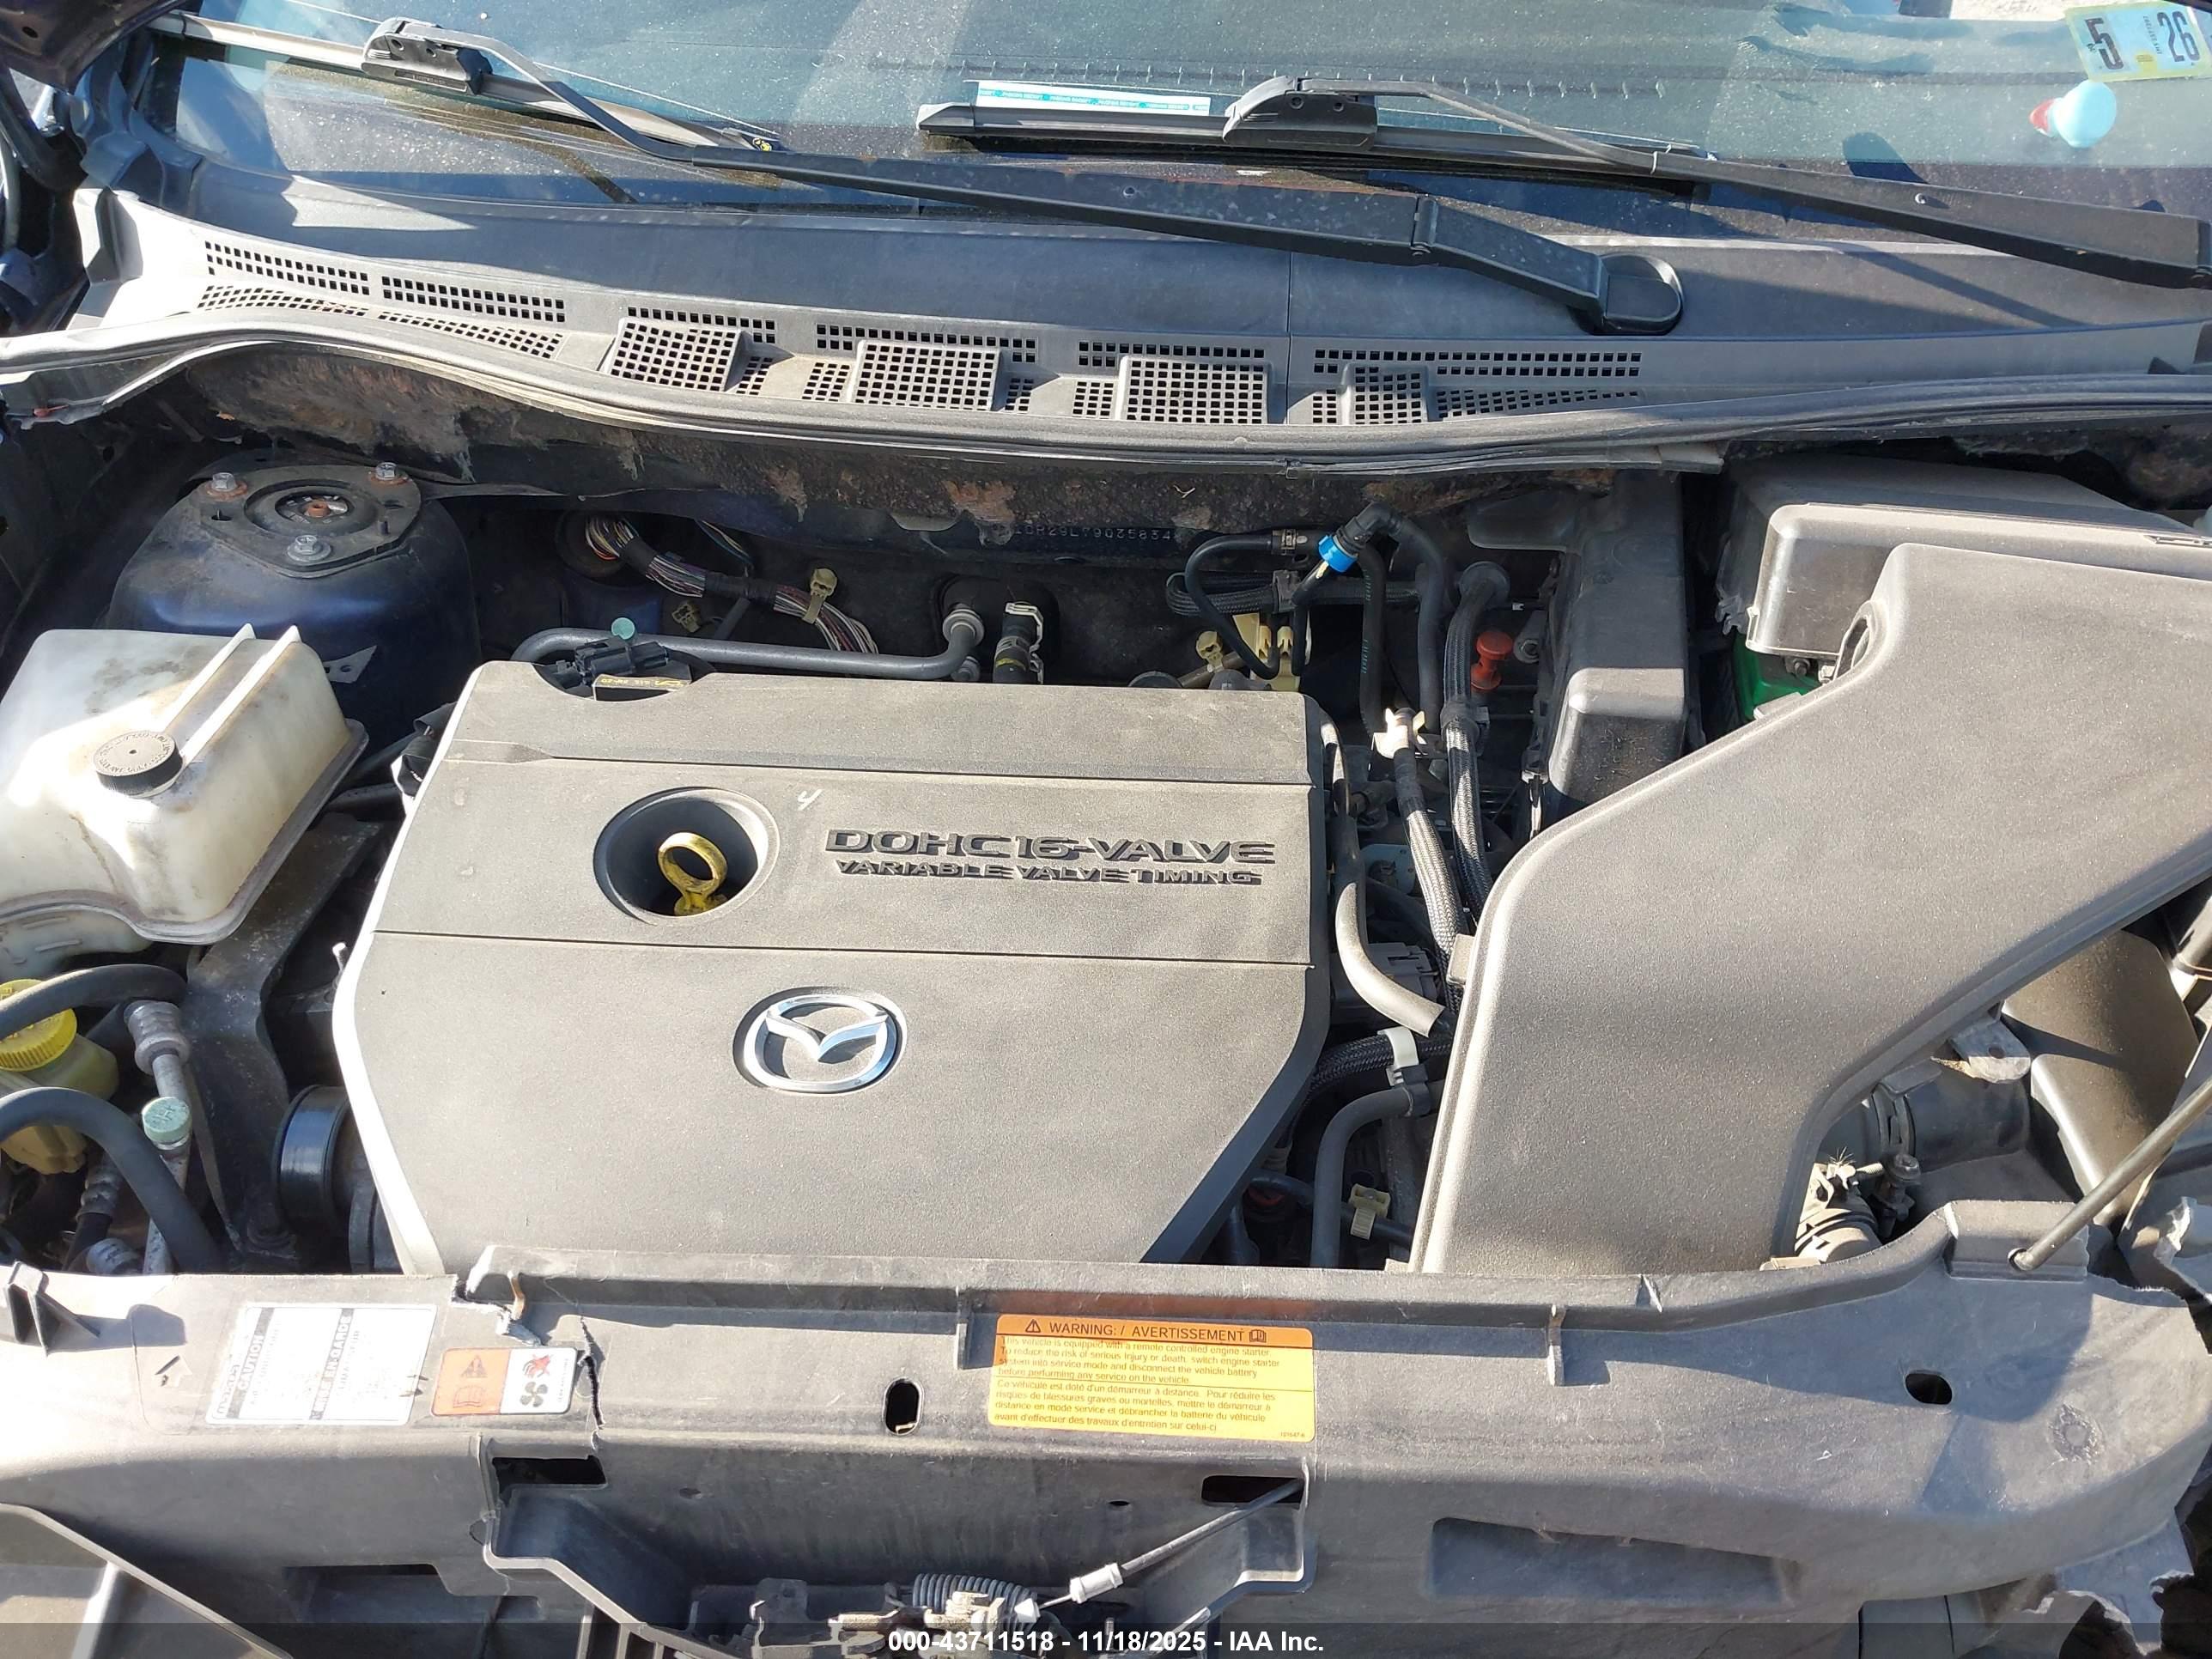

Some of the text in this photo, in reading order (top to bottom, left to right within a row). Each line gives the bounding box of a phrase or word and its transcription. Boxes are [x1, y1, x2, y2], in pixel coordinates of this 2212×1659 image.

[2085, 17, 2124, 70] 5
[2156, 11, 2201, 63] 26
[826, 830, 1276, 864] DOHC 16-VALVE
[836, 860, 1262, 885] VARIABLE VALVE TIMING
[330, 1316, 352, 1358] GARDE
[1049, 1322, 1117, 1336] WARNING:
[1132, 1327, 1245, 1343] AVERTISSEMENT
[238, 1335, 265, 1391] CAUTION
